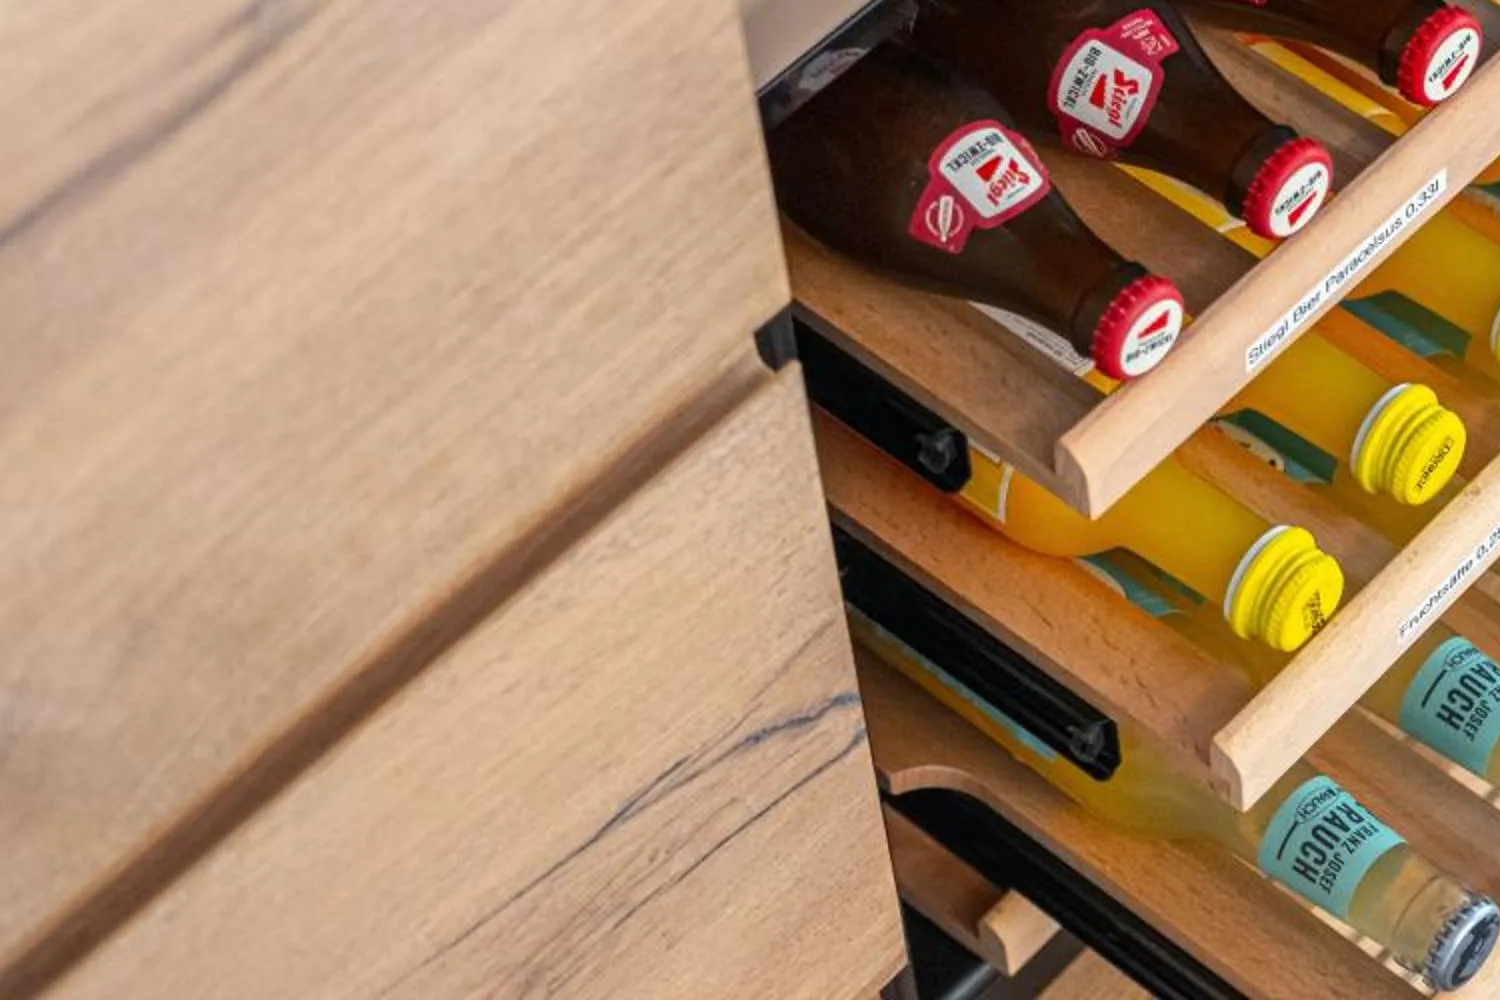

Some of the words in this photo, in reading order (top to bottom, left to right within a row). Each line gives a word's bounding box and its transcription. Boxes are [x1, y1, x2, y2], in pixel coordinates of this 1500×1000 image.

[1248, 318, 1290, 365] Stiegl
[1293, 292, 1322, 323] Bier
[1325, 216, 1403, 292] Paracelsus
[1462, 699, 1493, 742] JOSEF
[1291, 800, 1366, 885] RAUCH
[1341, 823, 1380, 855] FRANZ
[1318, 851, 1345, 896] JOSEF
